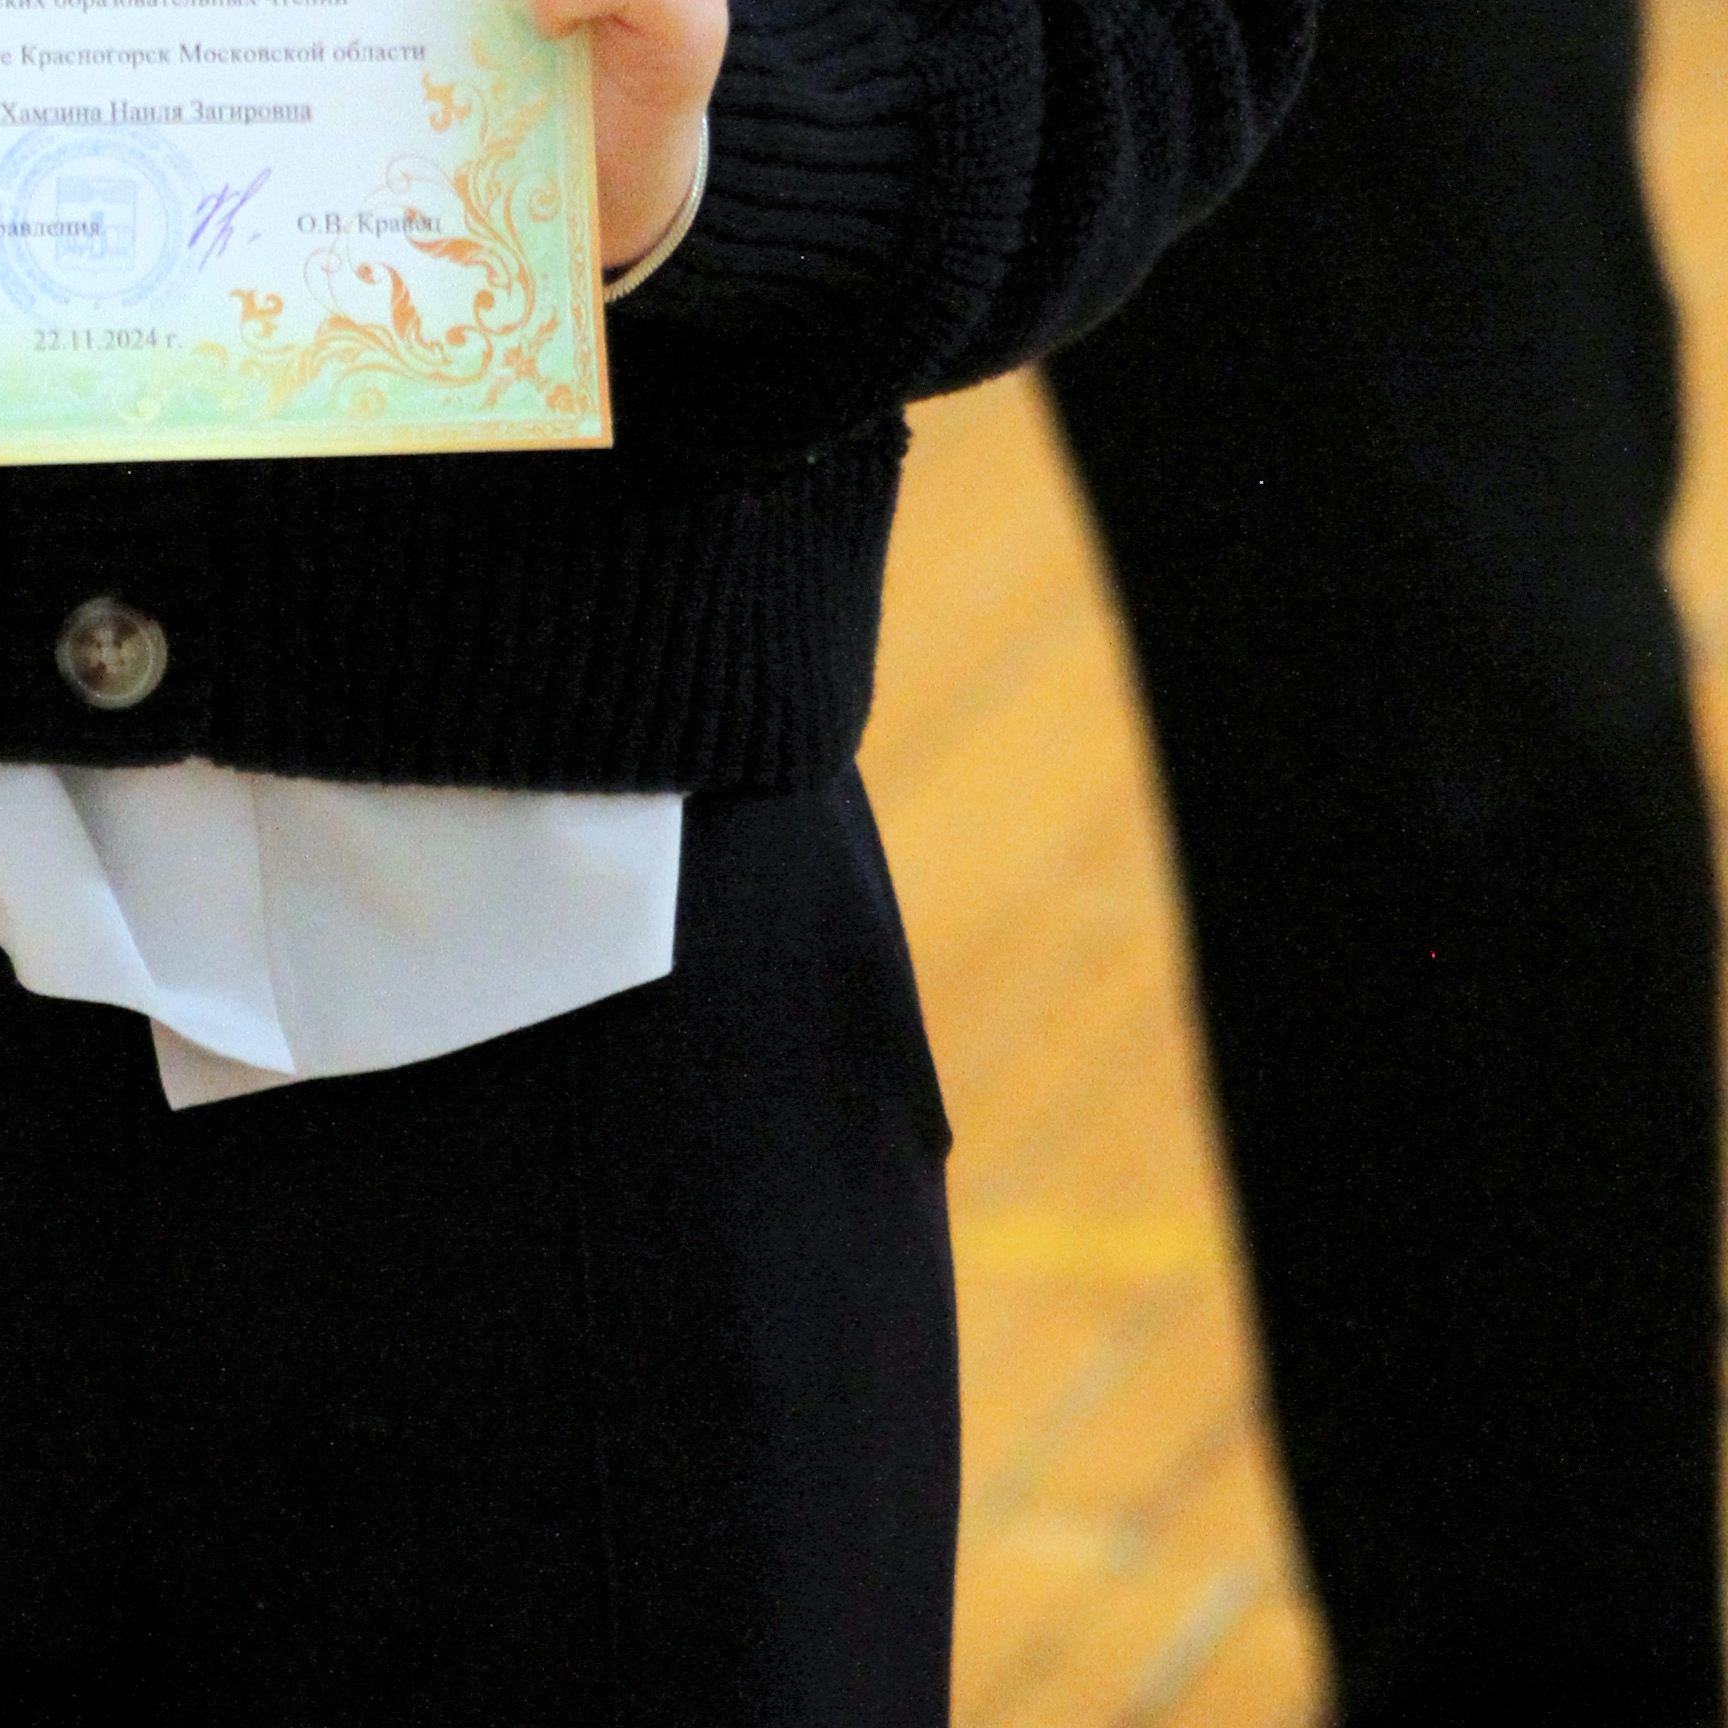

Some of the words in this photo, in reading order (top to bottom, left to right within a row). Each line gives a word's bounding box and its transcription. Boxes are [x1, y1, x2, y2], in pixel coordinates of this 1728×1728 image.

[20, 43, 171, 71] Красногорск
[178, 40, 326, 64] Московской
[332, 38, 428, 63] области
[35, 326, 159, 352] 22.11.2024
